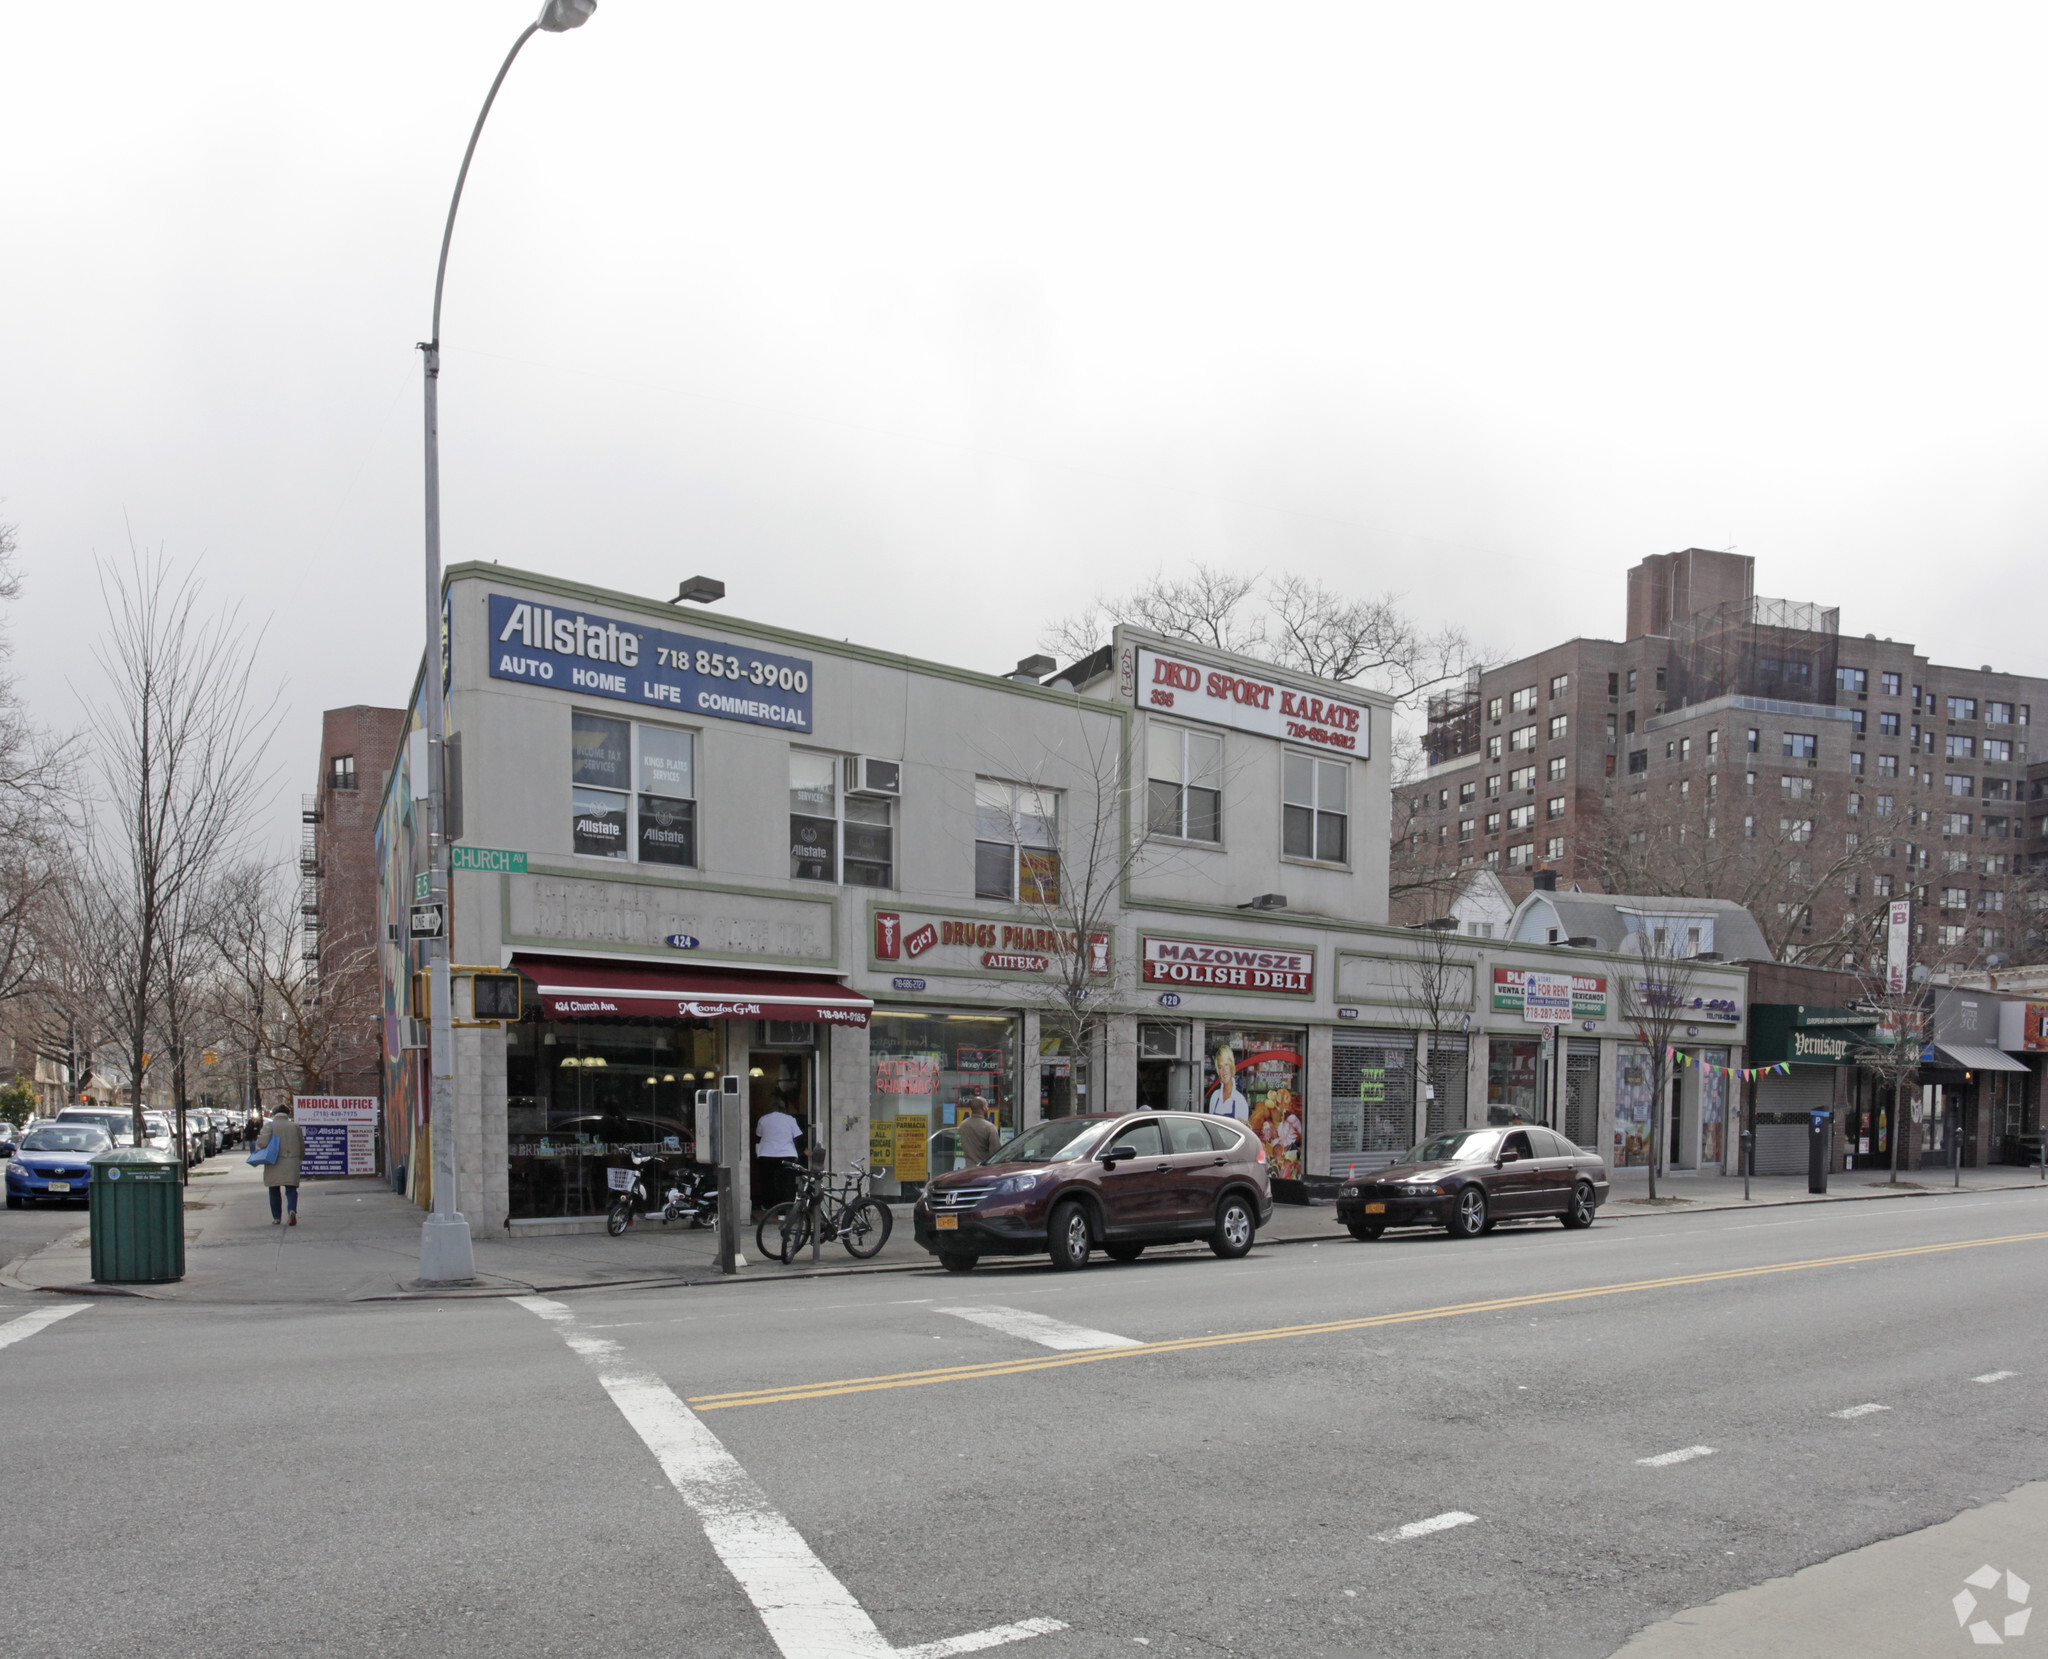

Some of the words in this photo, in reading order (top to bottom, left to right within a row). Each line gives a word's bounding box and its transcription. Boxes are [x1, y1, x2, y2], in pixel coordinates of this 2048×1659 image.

[499, 603, 640, 667] Allstate
[656, 647, 690, 671] 718
[695, 650, 809, 694] 853-3900
[499, 655, 554, 680] AUTO
[573, 667, 627, 694] HOME
[644, 681, 681, 704] LIFE
[698, 691, 806, 726] COMMERCIAL
[1150, 688, 1175, 708] 338
[1152, 658, 1202, 692] DKD
[1206, 672, 1275, 710] SPORT
[1279, 690, 1360, 732] KARATE
[607, 750, 622, 761] TAX
[584, 759, 616, 773] SERVICES
[643, 756, 664, 768] KINGS
[666, 760, 688, 771] PLATES
[652, 769, 680, 782] SERVICES
[797, 790, 824, 803] SERVICES
[576, 819, 620, 836] Allstate
[643, 828, 684, 843] Allstate
[791, 844, 827, 858] Allstate
[452, 847, 510, 871] CHURCH
[513, 854, 525, 864] AV
[416, 877, 422, 897] E
[422, 876, 428, 894] 5
[1891, 903, 1908, 911] HOT
[415, 915, 425, 929] ONE
[429, 913, 439, 927] WAY
[673, 935, 691, 948] 424
[910, 927, 932, 955] City
[941, 921, 996, 948] DRUGS
[1002, 925, 1090, 956] PHARMAC
[988, 955, 1045, 970] АПТЕКА
[1159, 944, 1302, 971] MAZOWSZE
[1153, 962, 1247, 985] POLISH
[1253, 970, 1307, 990] DELI
[1498, 986, 1520, 995] VENTA
[1538, 984, 1552, 996] FOR
[1553, 984, 1569, 997] RENT
[555, 1001, 570, 1011] 424
[570, 1001, 600, 1012] Church
[600, 1001, 618, 1012] Ave.
[1161, 995, 1179, 1006] 420
[1709, 999, 1736, 1012] SPA
[877, 1060, 941, 1078] АПТЕКА
[876, 1078, 940, 1095] PHARMACY
[297, 1098, 340, 1109] MEDICAL
[341, 1098, 373, 1109] OFFICE
[317, 1127, 346, 1135] Allstate
[885, 1149, 891, 1157] D
